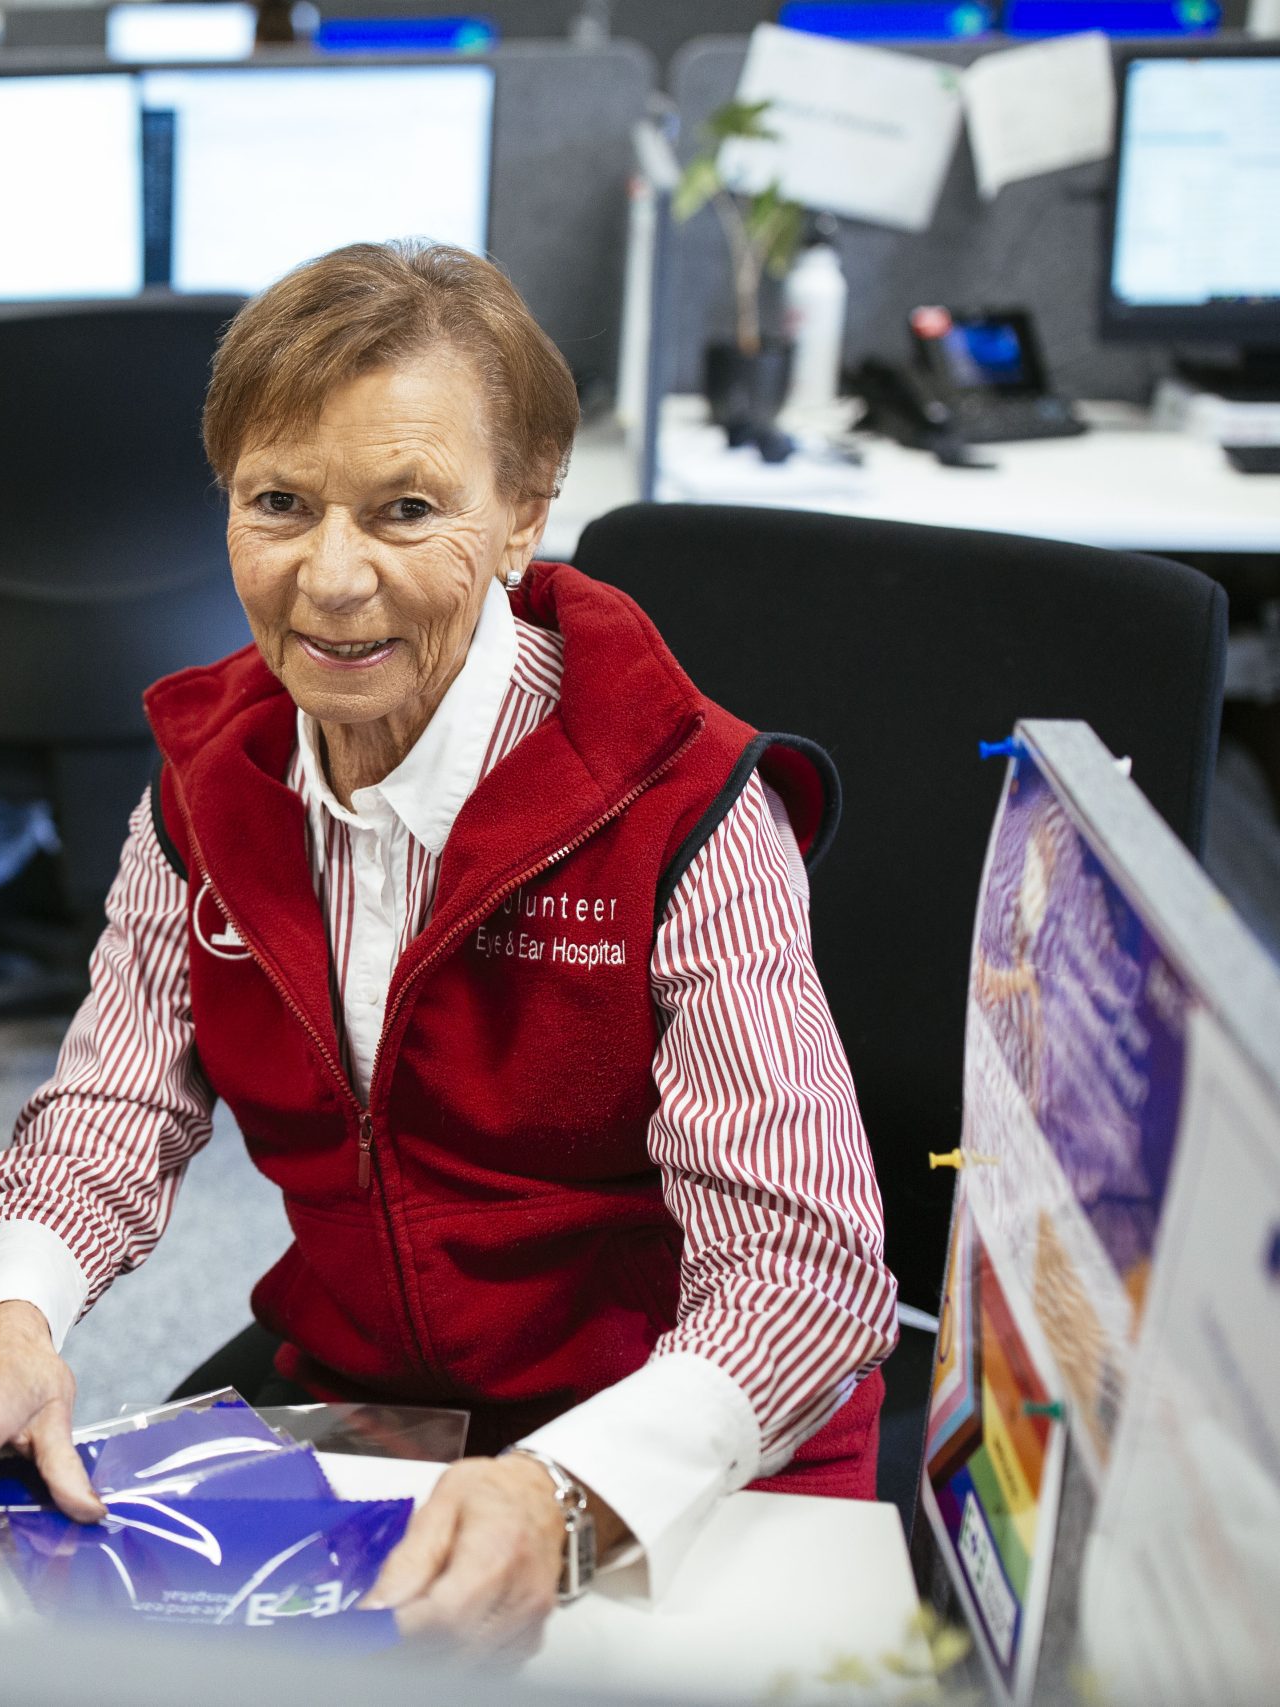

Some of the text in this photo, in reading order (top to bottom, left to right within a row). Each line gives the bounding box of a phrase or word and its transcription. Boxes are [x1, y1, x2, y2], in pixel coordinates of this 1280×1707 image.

[503, 886, 617, 922] olunteer
[475, 926, 626, 971] Eye & Ear Hospital
